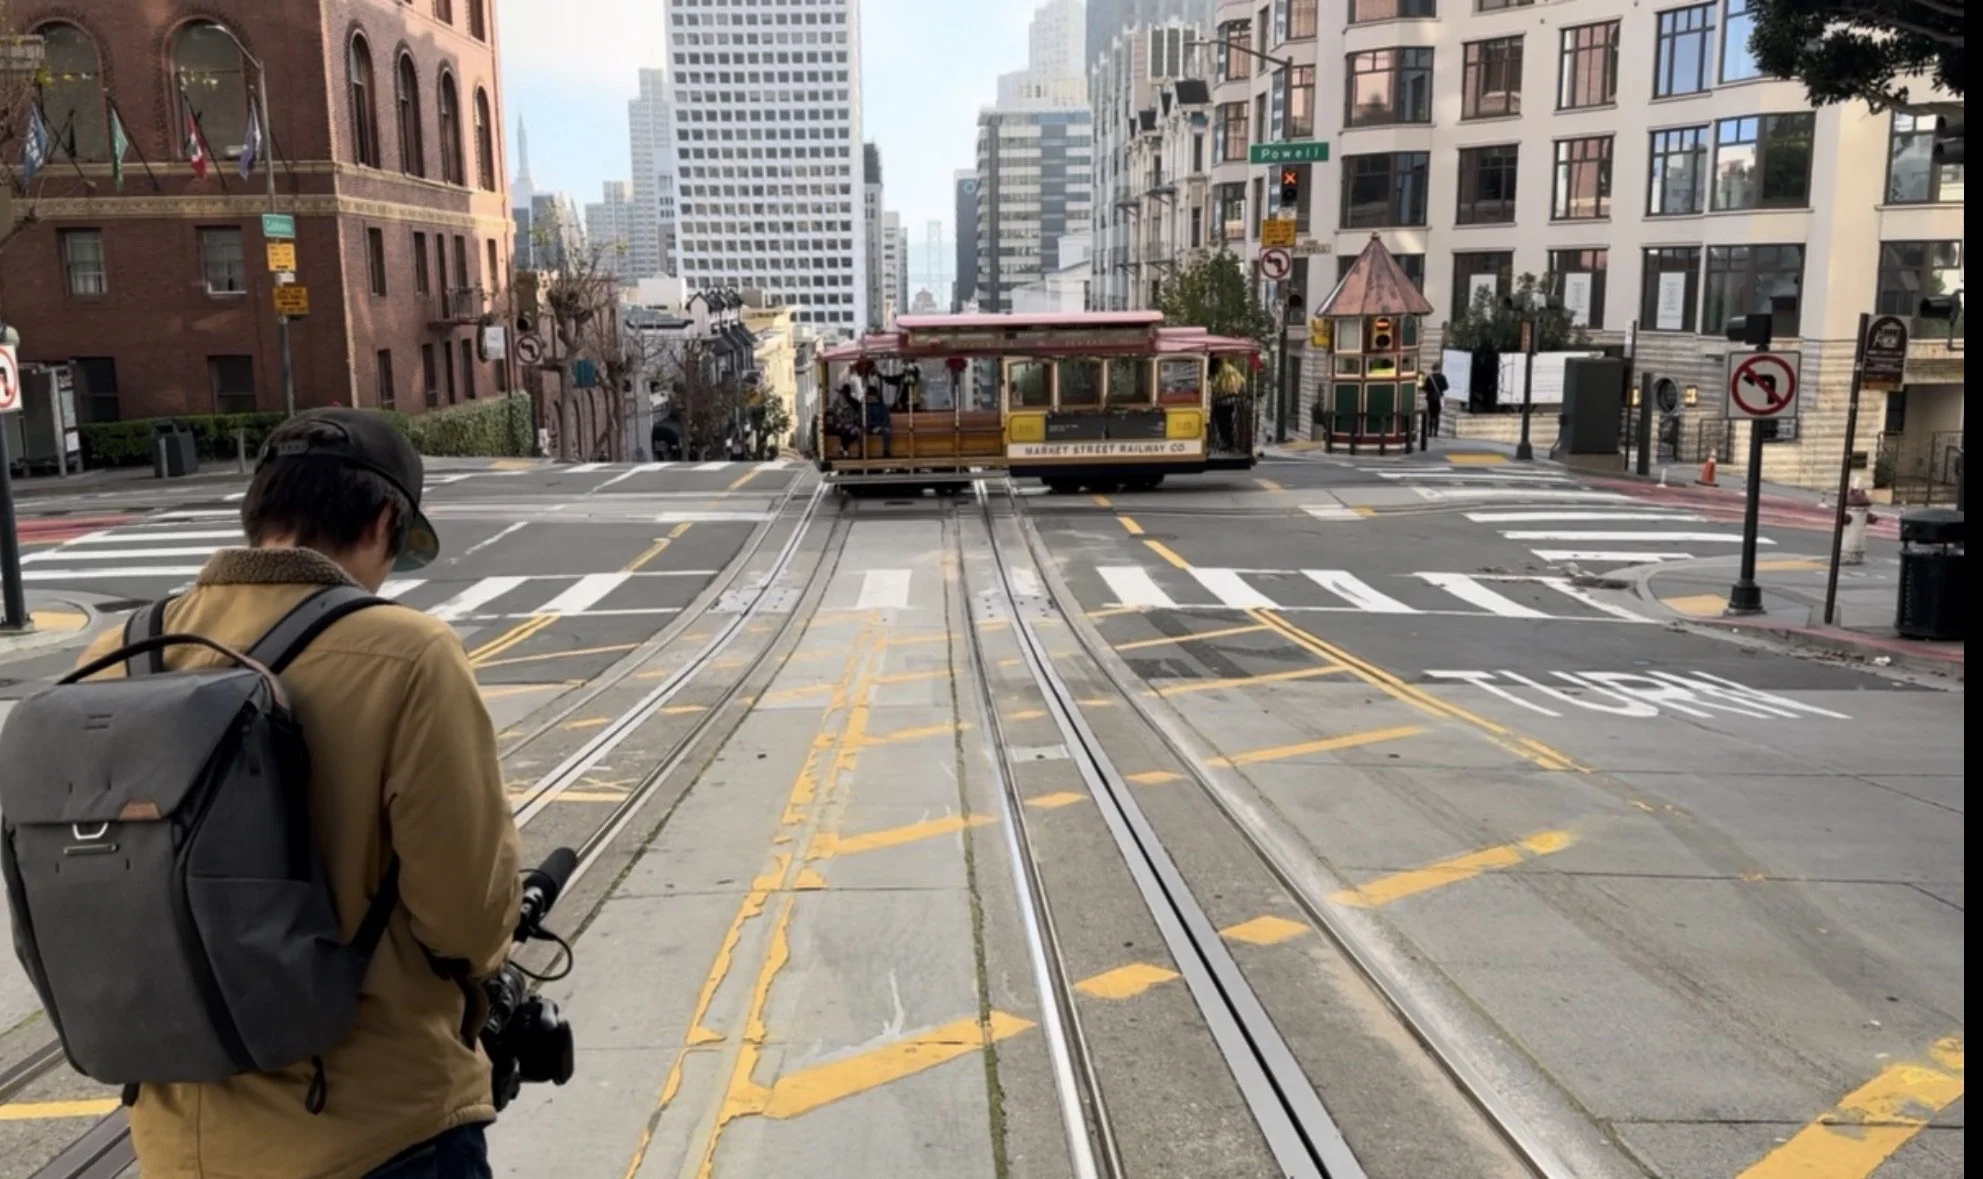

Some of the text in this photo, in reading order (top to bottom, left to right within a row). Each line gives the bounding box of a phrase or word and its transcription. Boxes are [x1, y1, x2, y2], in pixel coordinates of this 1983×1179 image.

[1261, 147, 1319, 160] Powell
[1025, 445, 1068, 455] MARKET
[1073, 443, 1115, 454] STREET
[1120, 443, 1165, 453] RAILWAY
[1422, 670, 1855, 720] TURN
